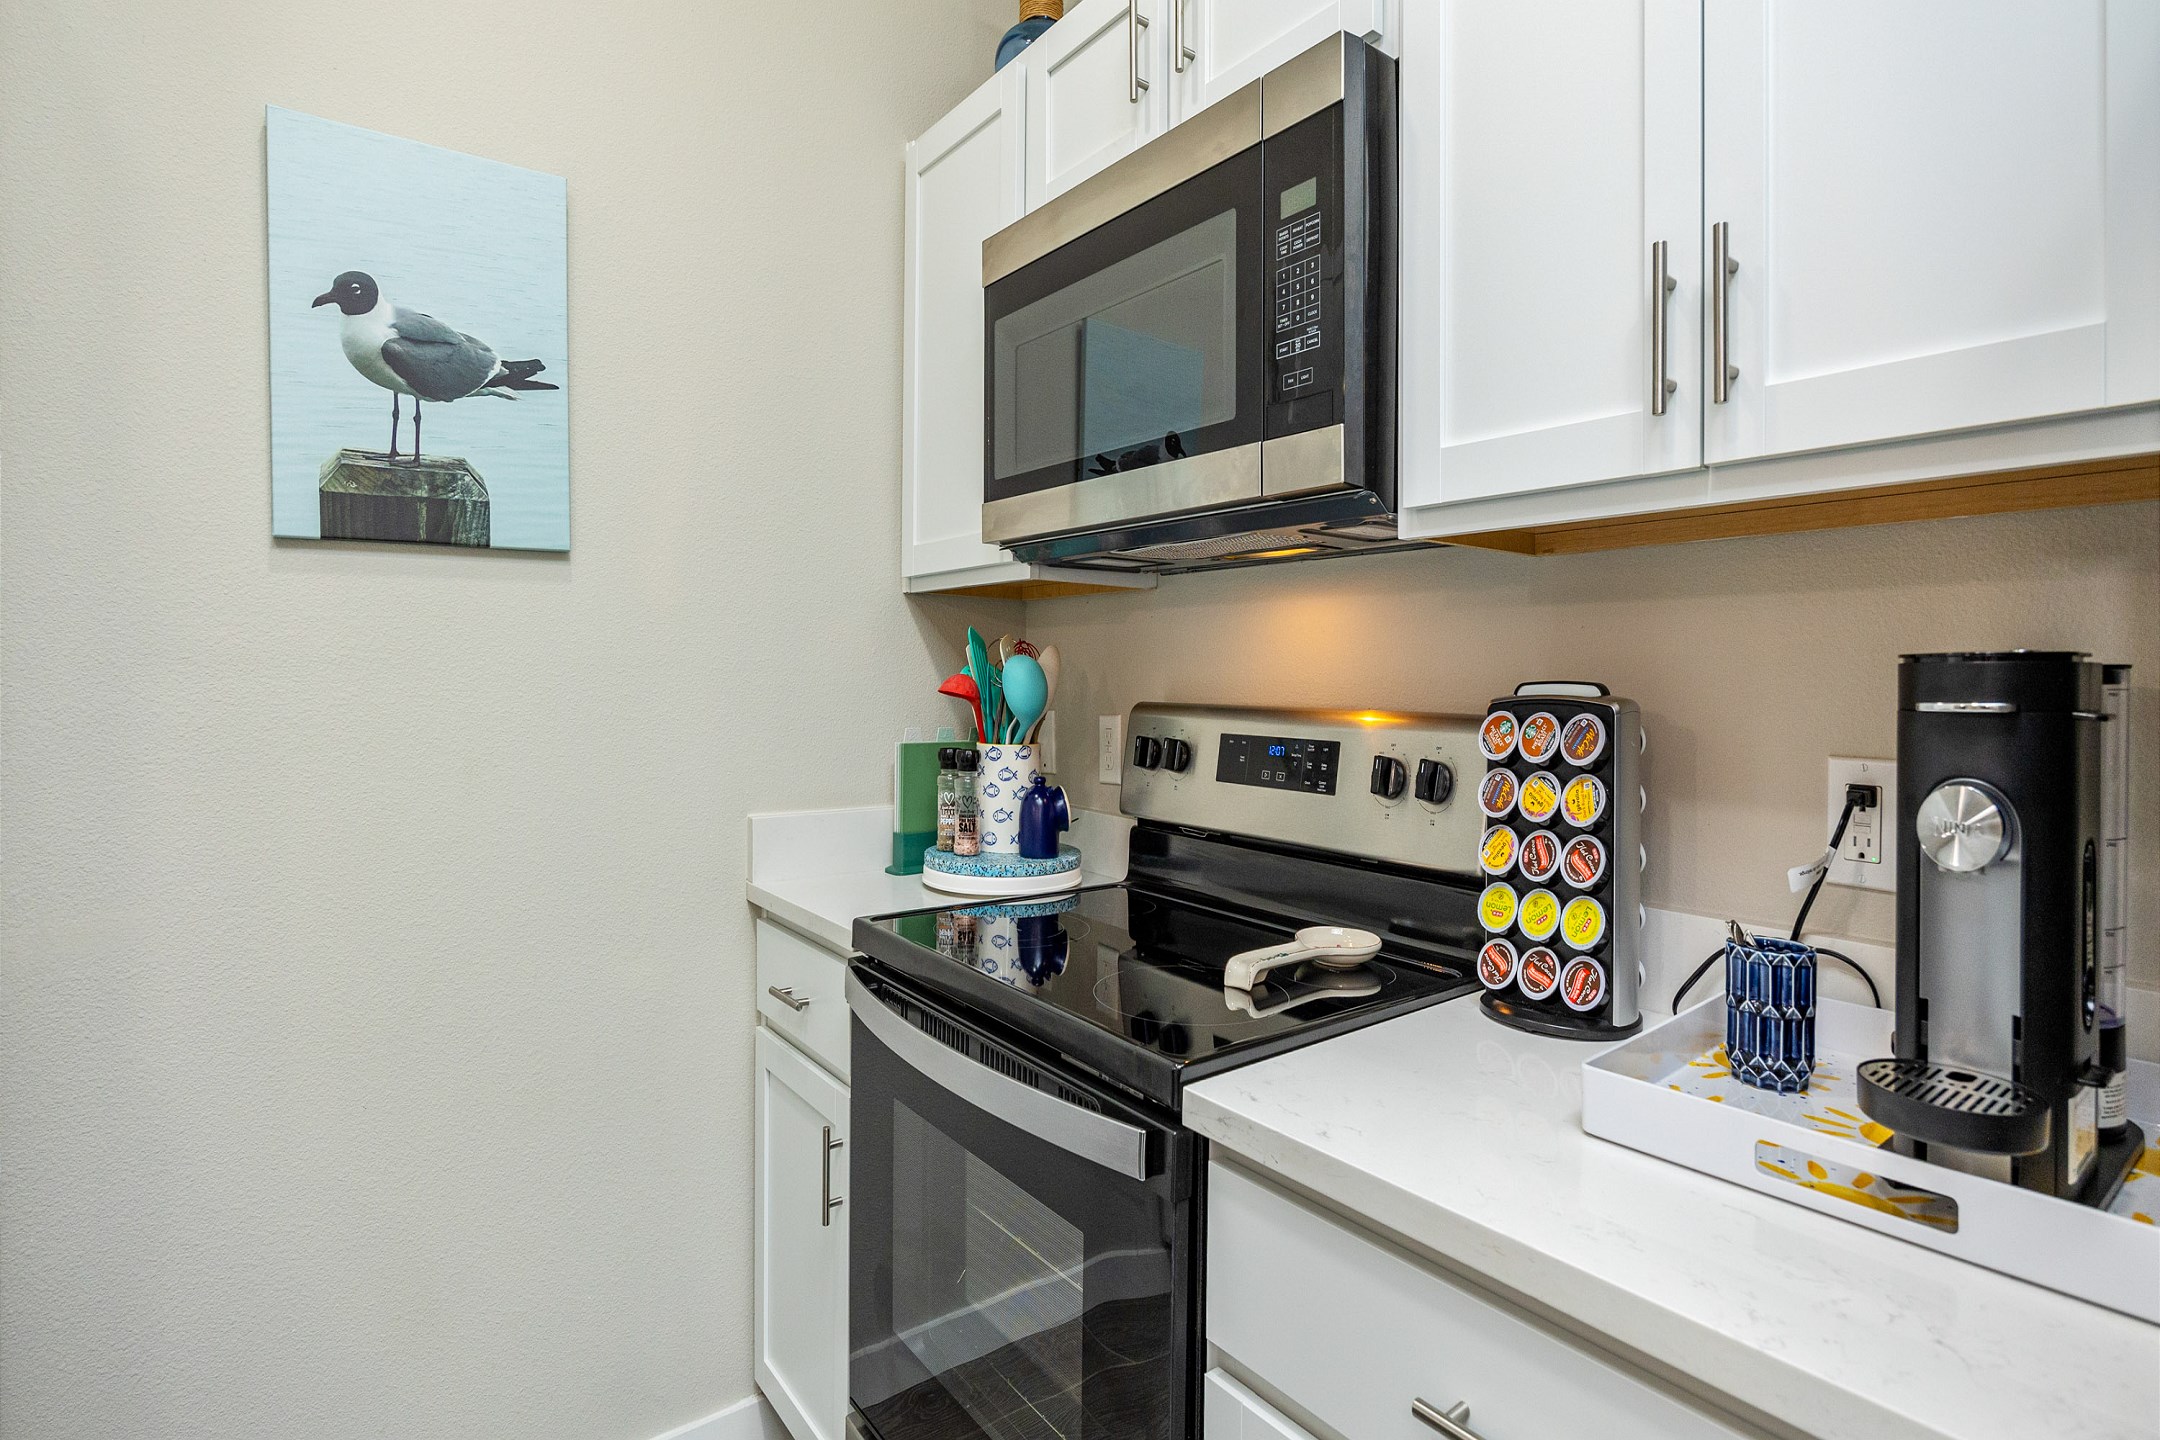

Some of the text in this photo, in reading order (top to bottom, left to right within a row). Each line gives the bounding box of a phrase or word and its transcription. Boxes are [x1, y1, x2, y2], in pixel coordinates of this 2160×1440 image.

[959, 823, 975, 832] SALT
[1576, 842, 1596, 873] Hot Cocoa
[1486, 902, 1512, 913] Lemon
[1526, 903, 1553, 924] Lemon
[1571, 906, 1592, 938] Lemon
[1484, 953, 1503, 983] Hot Cocoa
[1529, 954, 1543, 967] Hot
[1541, 964, 1554, 980] Cocoa
[1576, 968, 1597, 1004] Hot Cocoa
